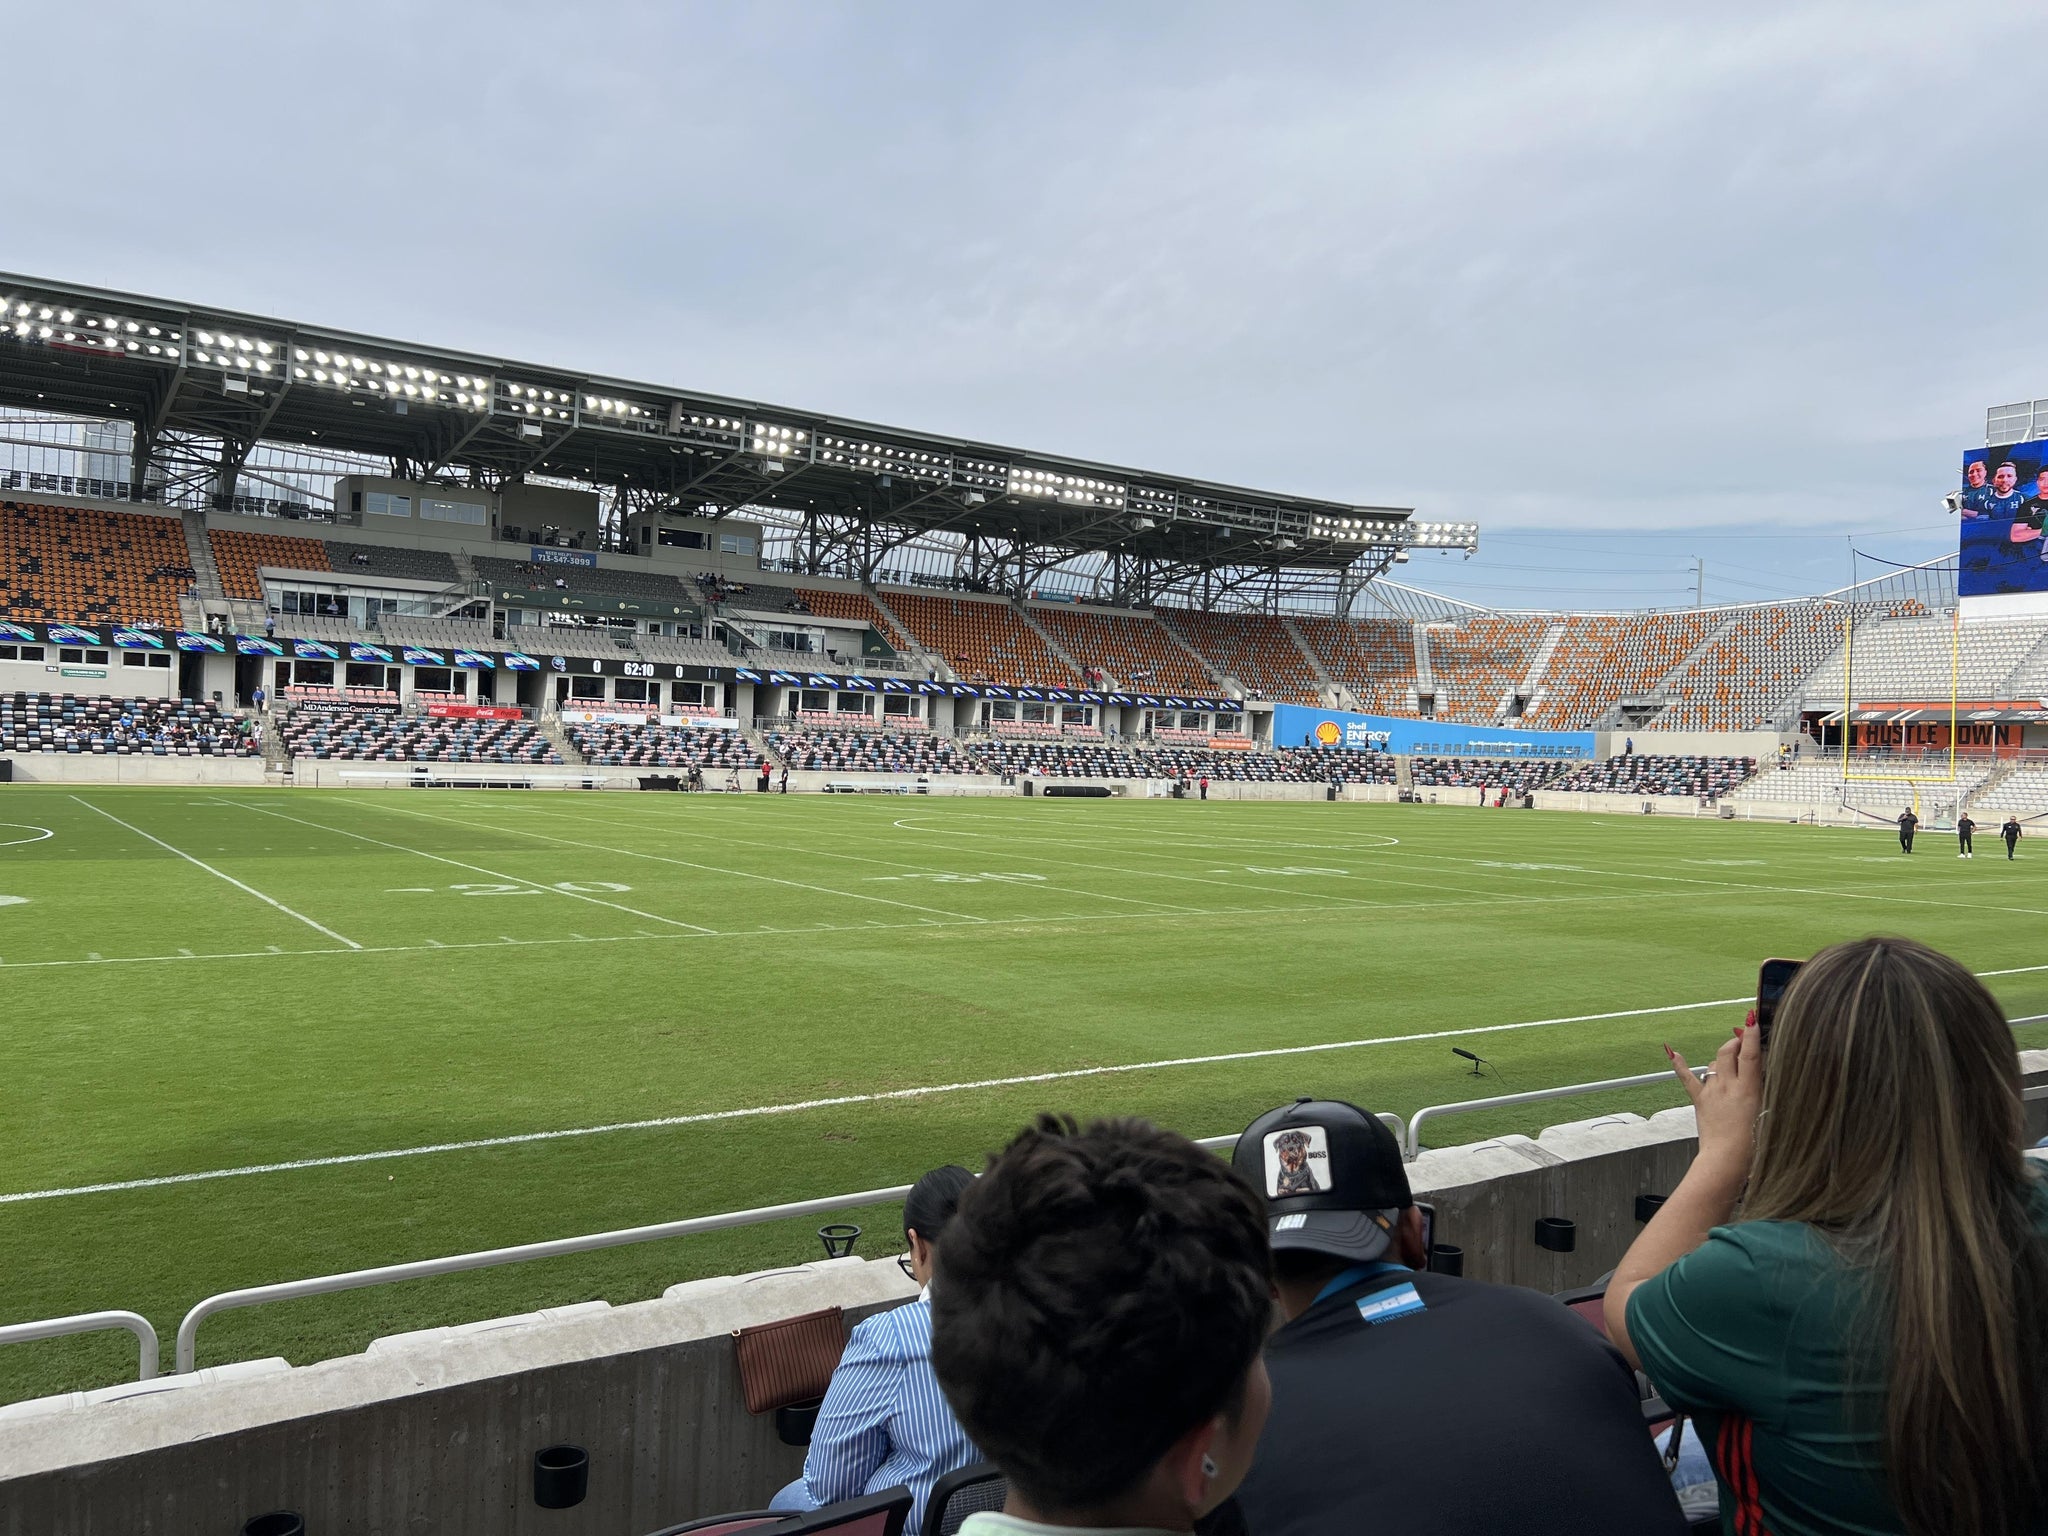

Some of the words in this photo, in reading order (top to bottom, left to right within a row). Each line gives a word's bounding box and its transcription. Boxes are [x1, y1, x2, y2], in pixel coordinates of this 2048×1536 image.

[537, 554, 591, 566] 713-547-3099
[593, 660, 601, 673] 0
[624, 662, 654, 677] 62:10
[675, 665, 684, 679] 0
[303, 703, 316, 711] MD
[316, 703, 349, 712] Anderson
[349, 705, 373, 713] Cancer
[373, 706, 397, 714] Center
[1346, 722, 1367, 730] Shell
[1866, 725, 1938, 744] HUSTLE
[1308, 1151, 1327, 1159] BOSS
